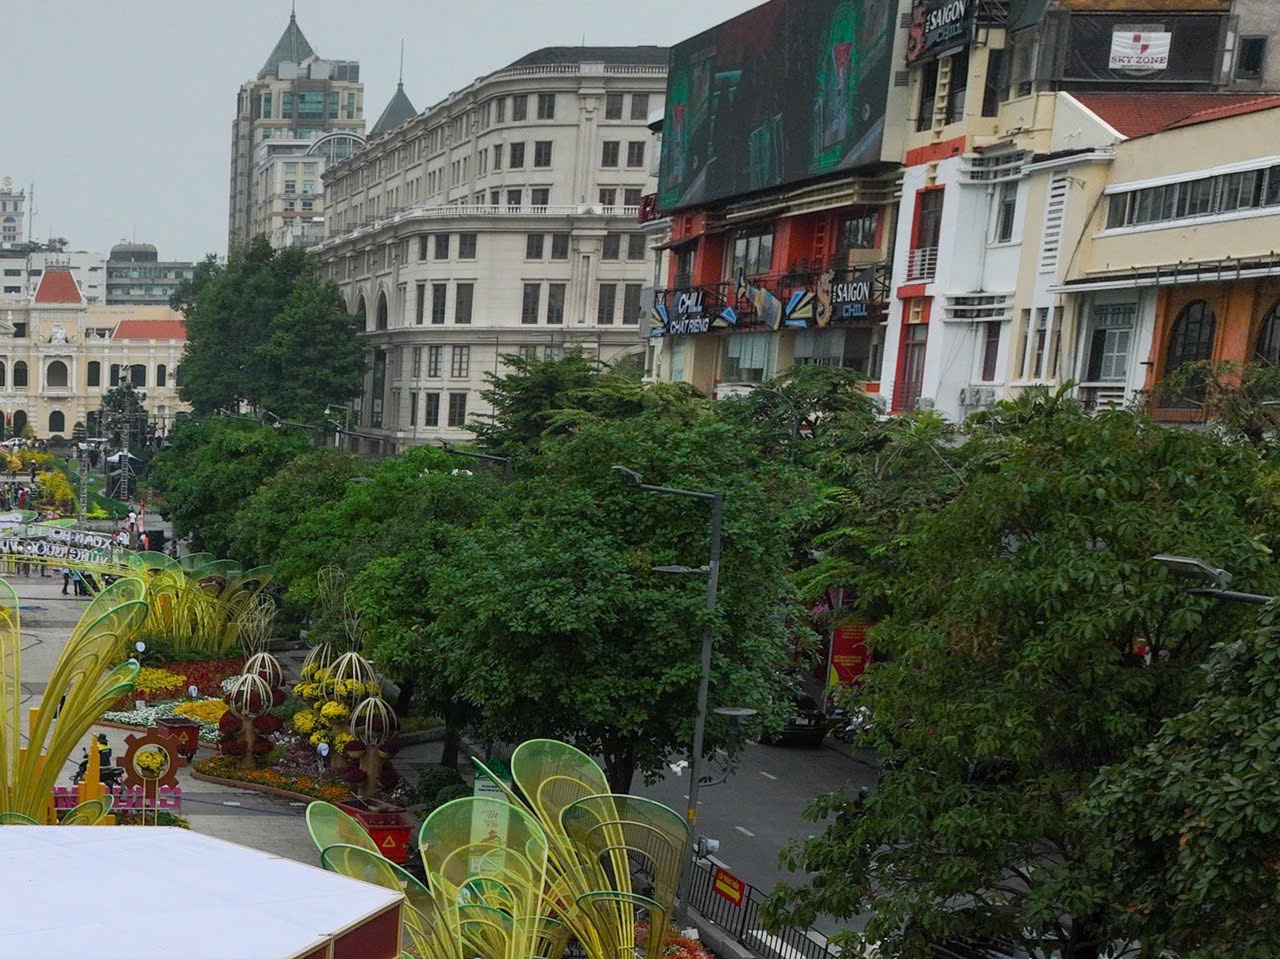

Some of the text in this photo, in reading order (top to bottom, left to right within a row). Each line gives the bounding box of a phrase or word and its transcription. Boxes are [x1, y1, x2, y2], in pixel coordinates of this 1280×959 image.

[930, 0, 969, 30] SAIGON
[1111, 56, 1167, 64] SKY ZONE
[836, 282, 870, 302] SAIGON
[679, 291, 705, 314] CHILL
[843, 303, 868, 317] CHILL
